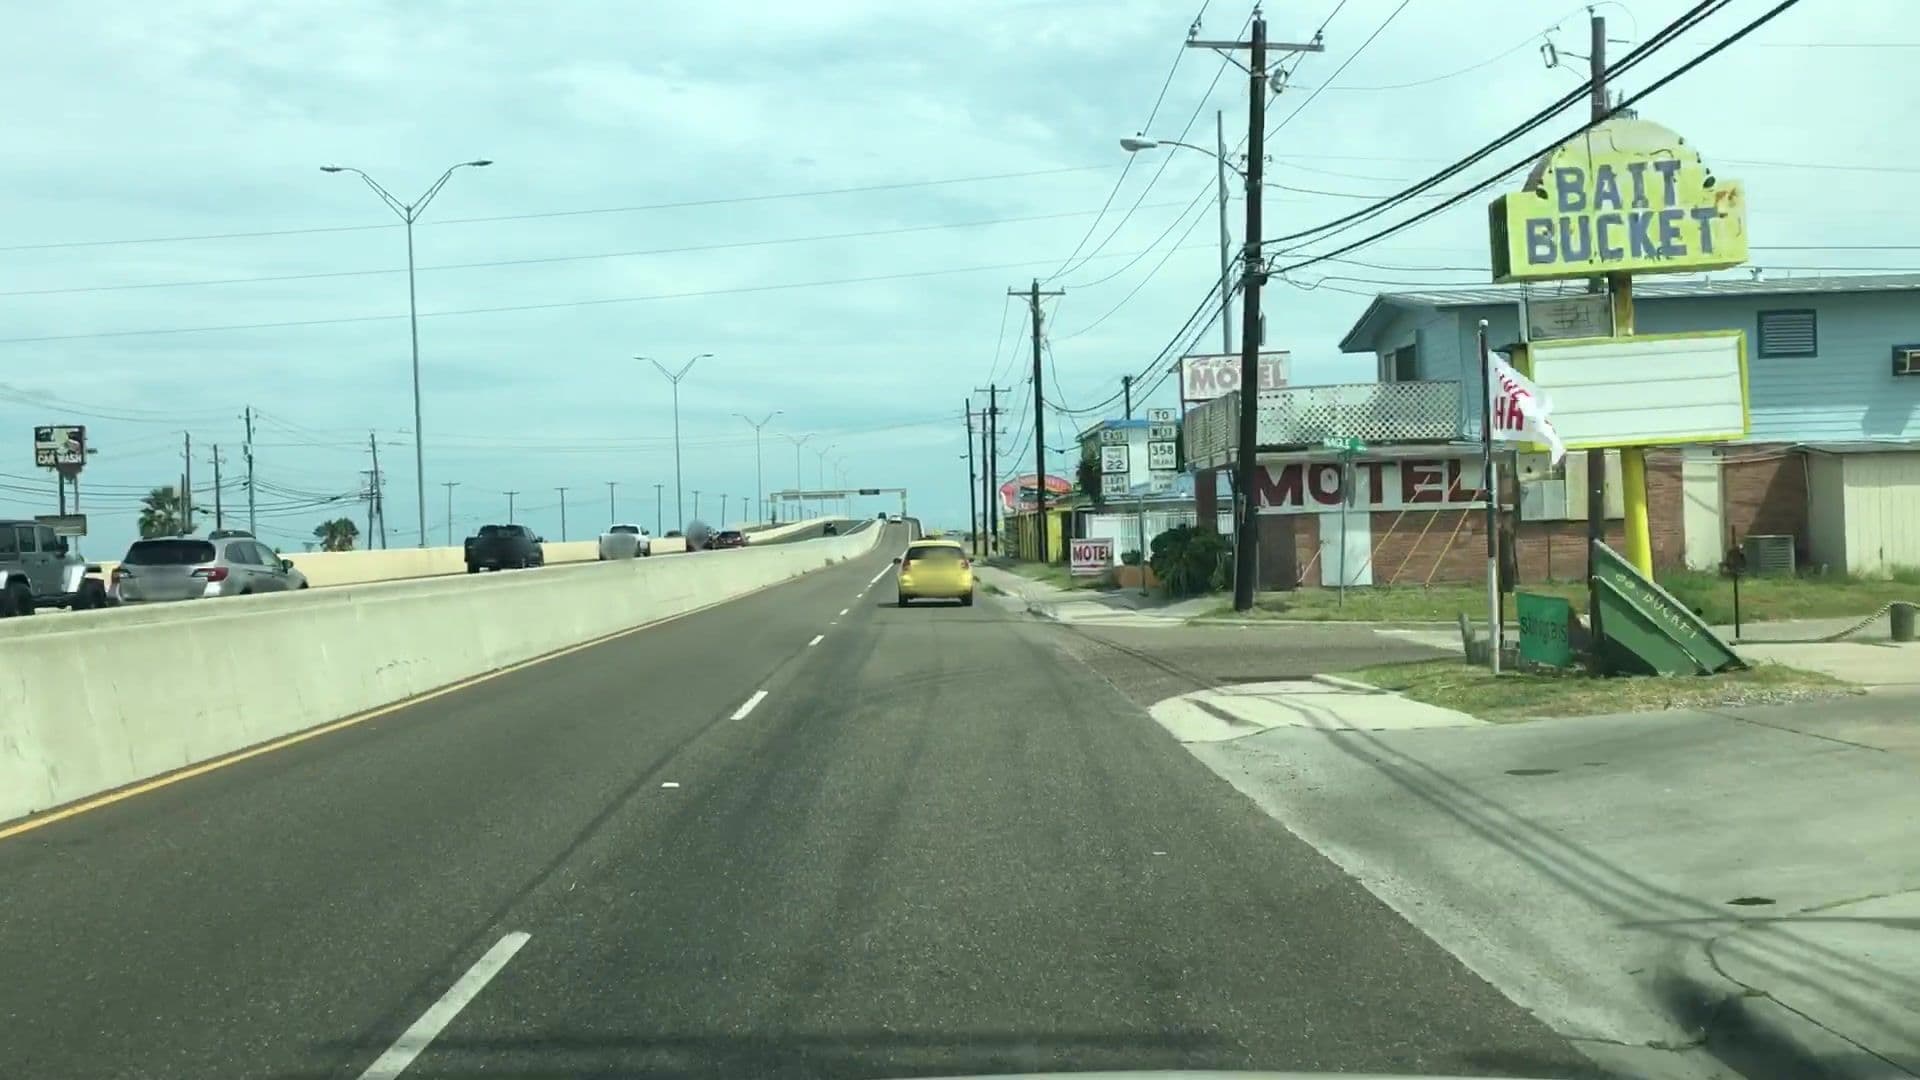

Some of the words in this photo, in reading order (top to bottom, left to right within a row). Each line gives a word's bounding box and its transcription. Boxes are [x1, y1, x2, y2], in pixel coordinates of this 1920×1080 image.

[1556, 160, 1681, 213] BAIT
[1526, 207, 1719, 265] BUCKET
[1189, 359, 1288, 390] MOEL
[1154, 411, 1169, 420] TO
[1152, 446, 1174, 455] 358
[1106, 460, 1124, 470] 22
[1254, 460, 1487, 506] MOTEL
[1073, 547, 1110, 561] MOTEL
